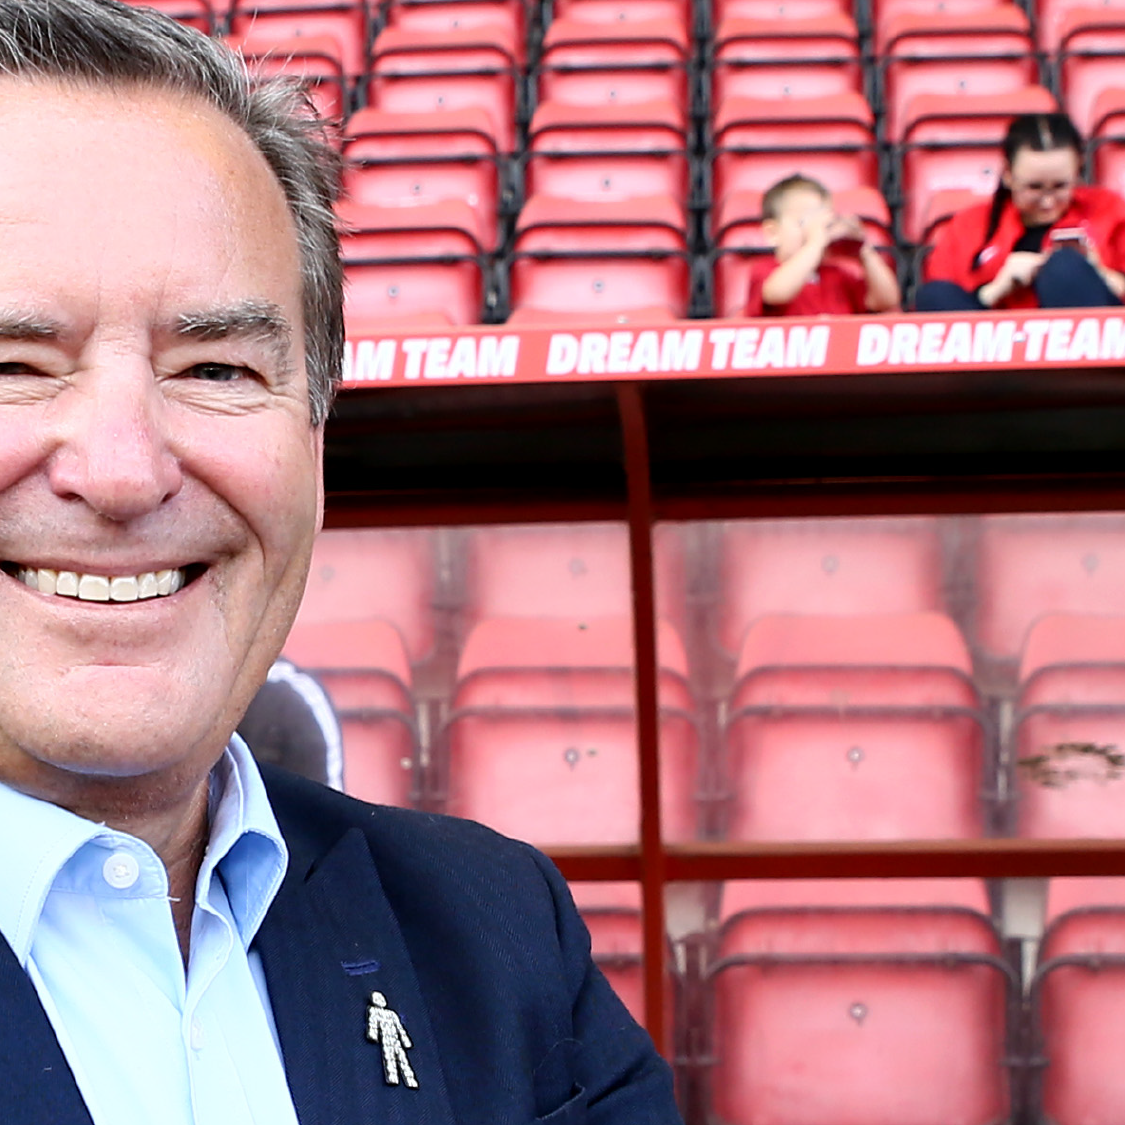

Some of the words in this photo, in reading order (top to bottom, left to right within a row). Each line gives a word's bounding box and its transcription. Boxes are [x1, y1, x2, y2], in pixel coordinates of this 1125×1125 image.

[402, 336, 519, 379] TEAM
[546, 330, 703, 375] DREAM
[710, 326, 830, 369] TEAM
[857, 321, 1015, 365] DREAM
